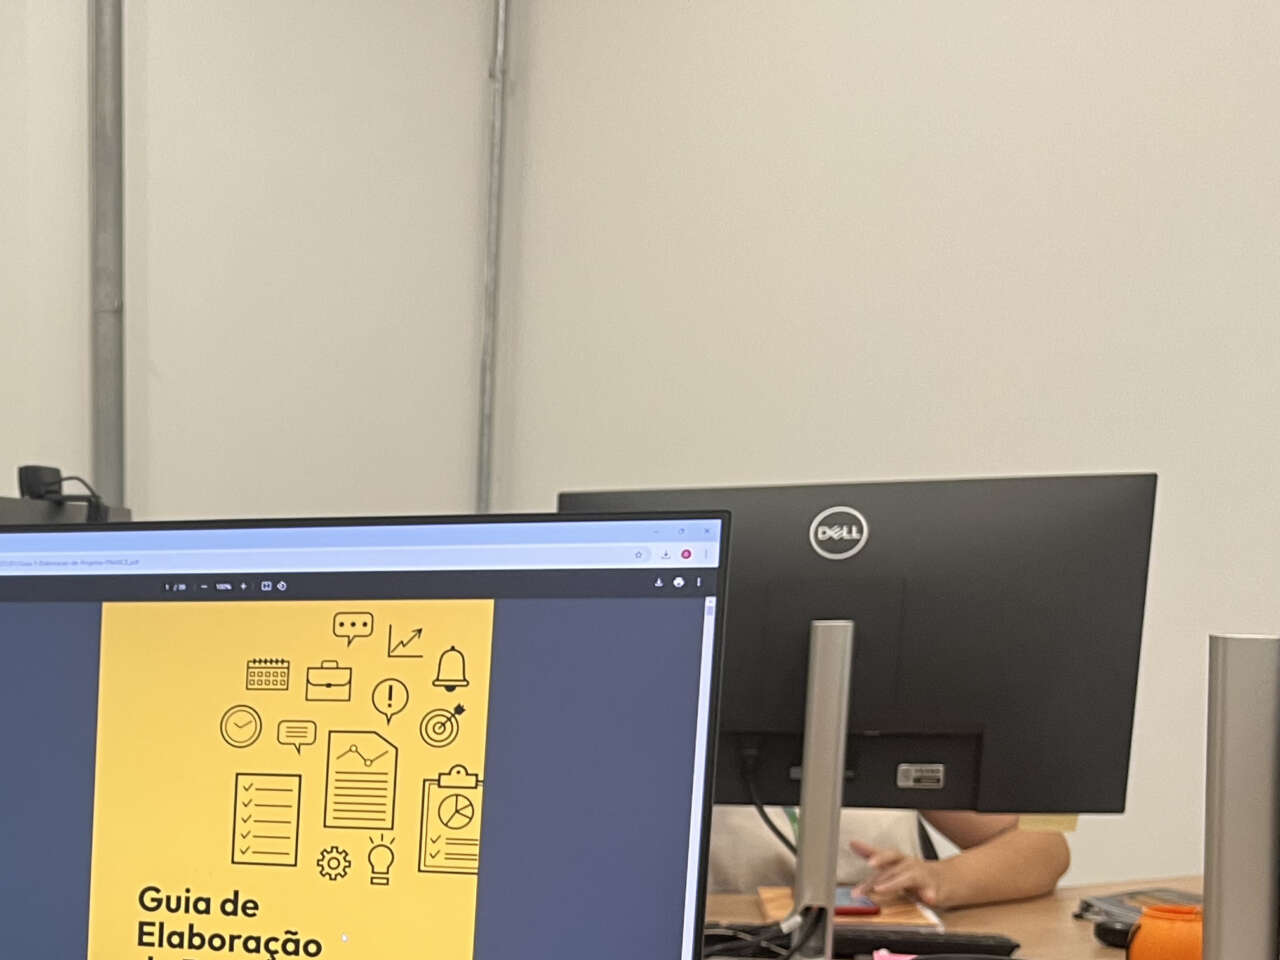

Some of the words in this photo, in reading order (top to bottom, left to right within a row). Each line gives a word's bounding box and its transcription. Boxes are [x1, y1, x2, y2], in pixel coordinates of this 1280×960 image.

[817, 525, 861, 541] DELL
[137, 885, 211, 916] Guia
[219, 889, 260, 918] de
